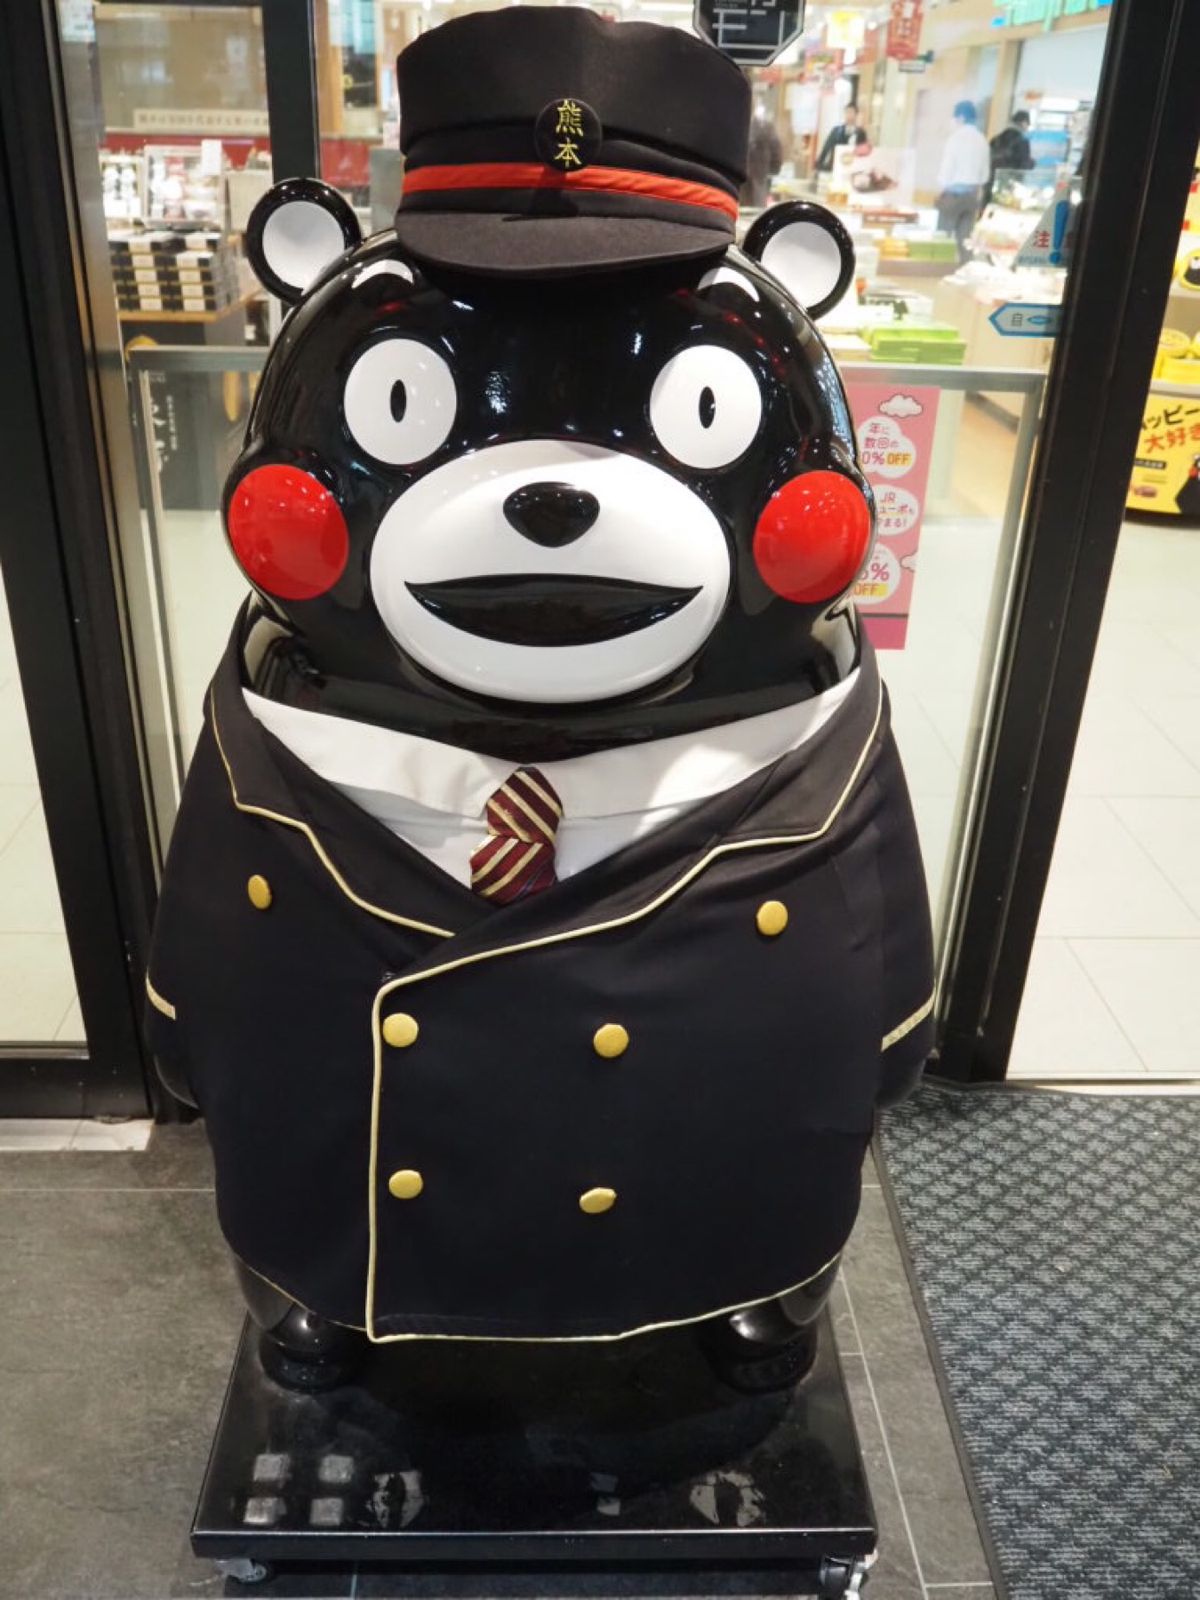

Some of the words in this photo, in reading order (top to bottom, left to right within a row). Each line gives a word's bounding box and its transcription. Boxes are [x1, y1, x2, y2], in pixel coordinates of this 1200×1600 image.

[554, 99, 584, 168] 熊本
[887, 453, 911, 465] OFF
[880, 491, 896, 503] JR
[854, 583, 881, 596] OFF
